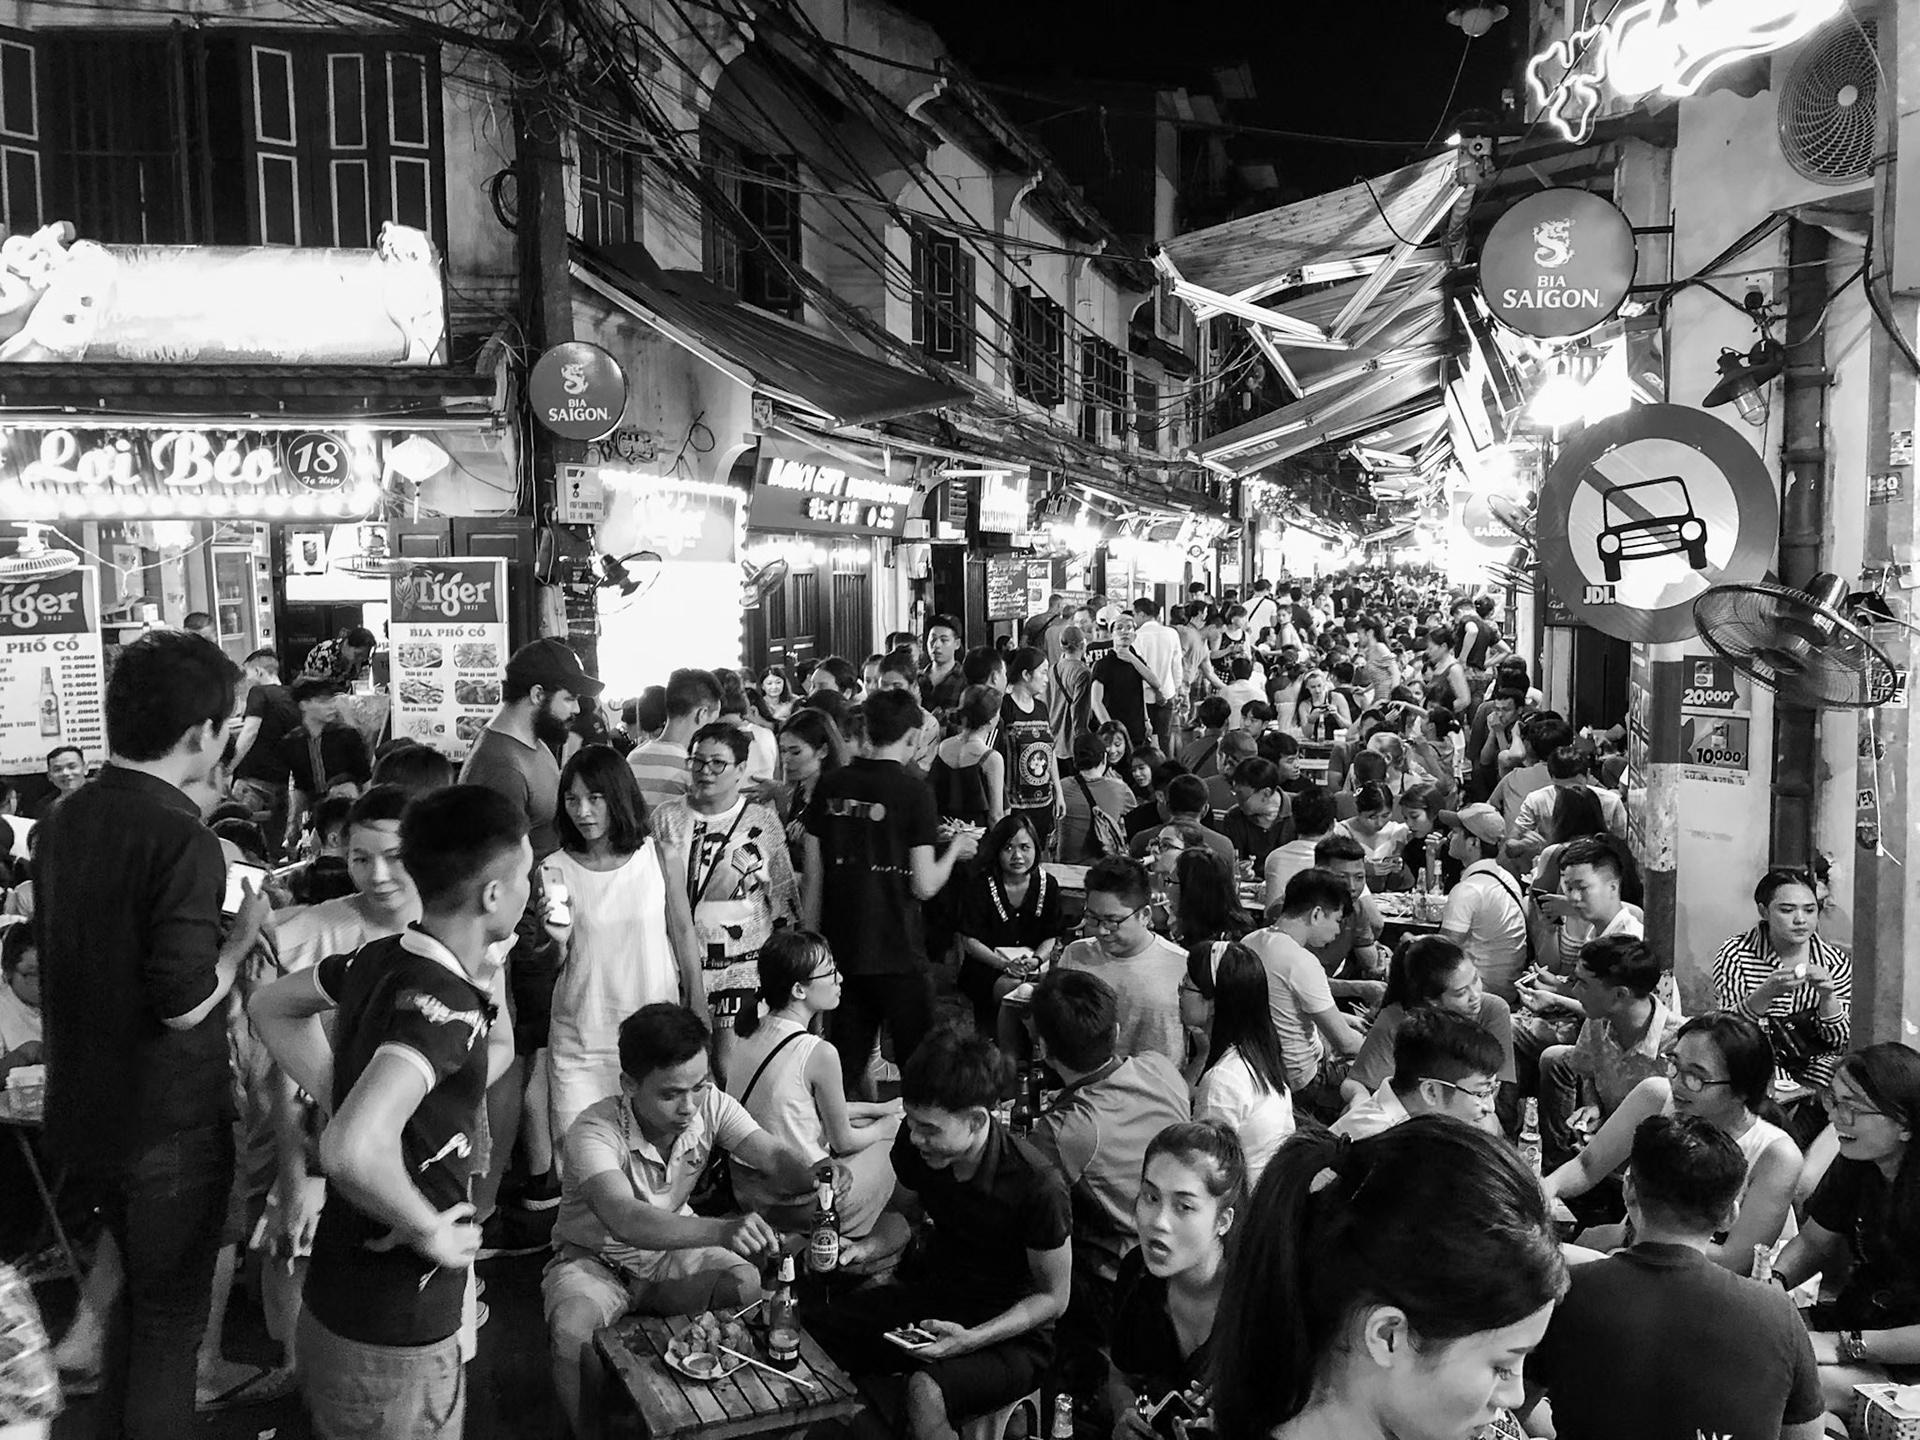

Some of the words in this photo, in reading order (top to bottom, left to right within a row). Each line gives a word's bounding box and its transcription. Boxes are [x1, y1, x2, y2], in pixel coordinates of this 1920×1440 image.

[1537, 275, 1567, 287] BIA
[1502, 289, 1600, 308] SAIGON
[568, 399, 587, 408] BIA
[549, 407, 609, 421] SAIGON
[293, 441, 339, 474] 18
[413, 571, 492, 617] Tiger
[409, 628, 433, 637] BIA
[437, 625, 464, 637] PHỐ
[6, 636, 47, 653] PHỐ
